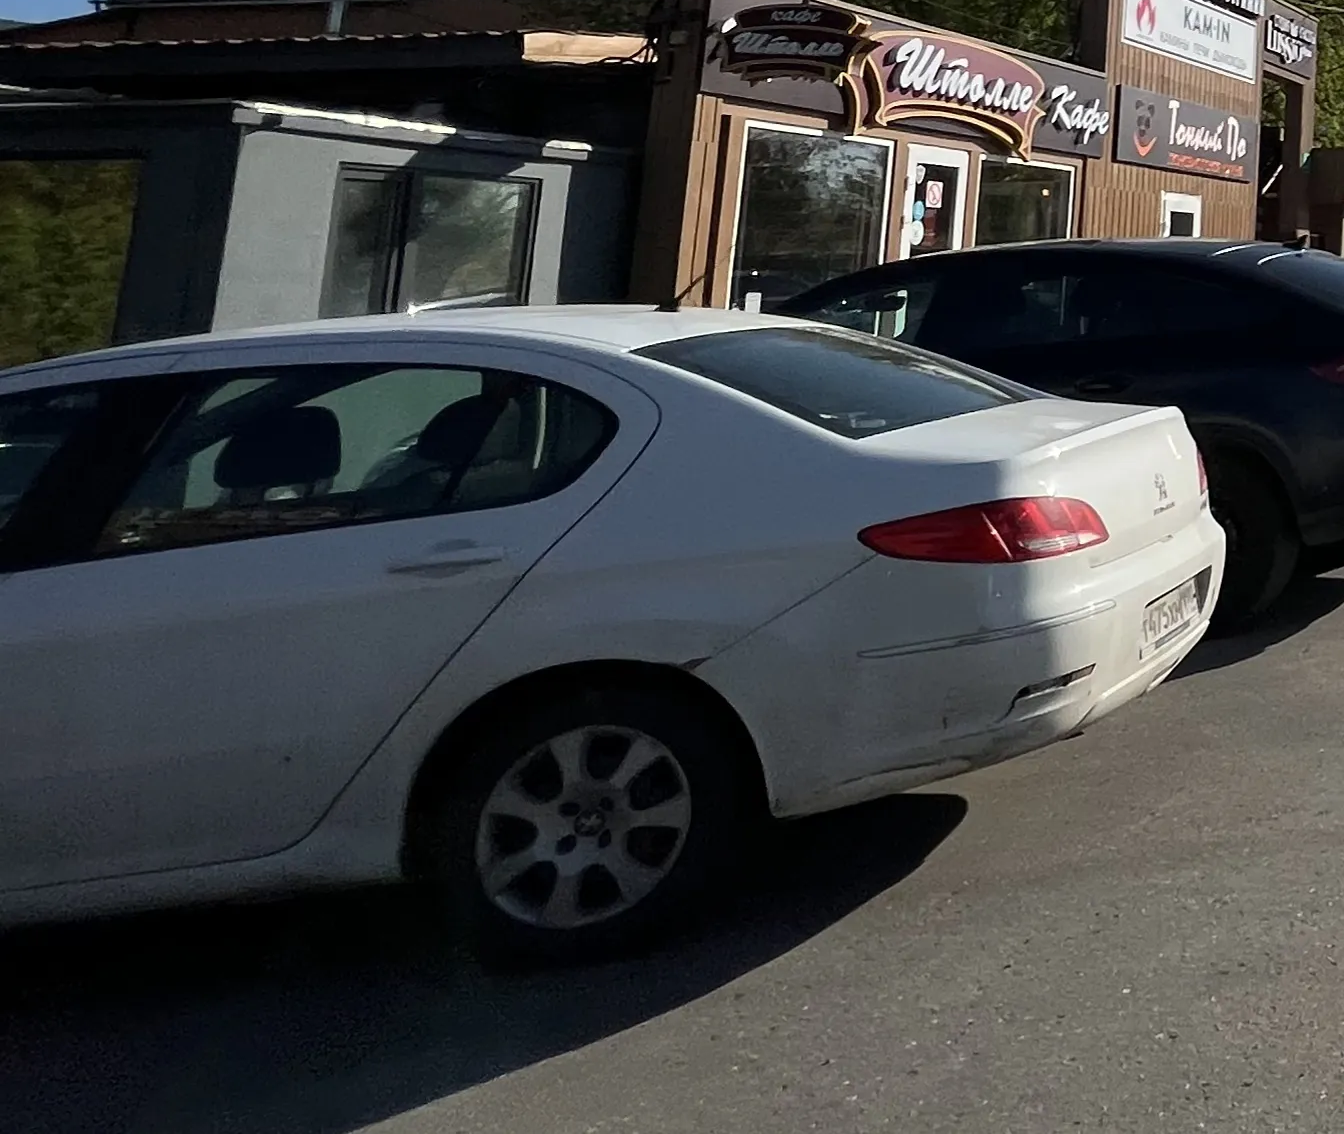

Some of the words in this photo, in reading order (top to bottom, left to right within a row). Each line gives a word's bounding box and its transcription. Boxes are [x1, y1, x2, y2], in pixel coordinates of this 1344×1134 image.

[770, 8, 821, 24] кафе
[732, 31, 844, 56] Штолле
[896, 37, 1034, 113] Штолле
[1050, 84, 1110, 145] Кафе
